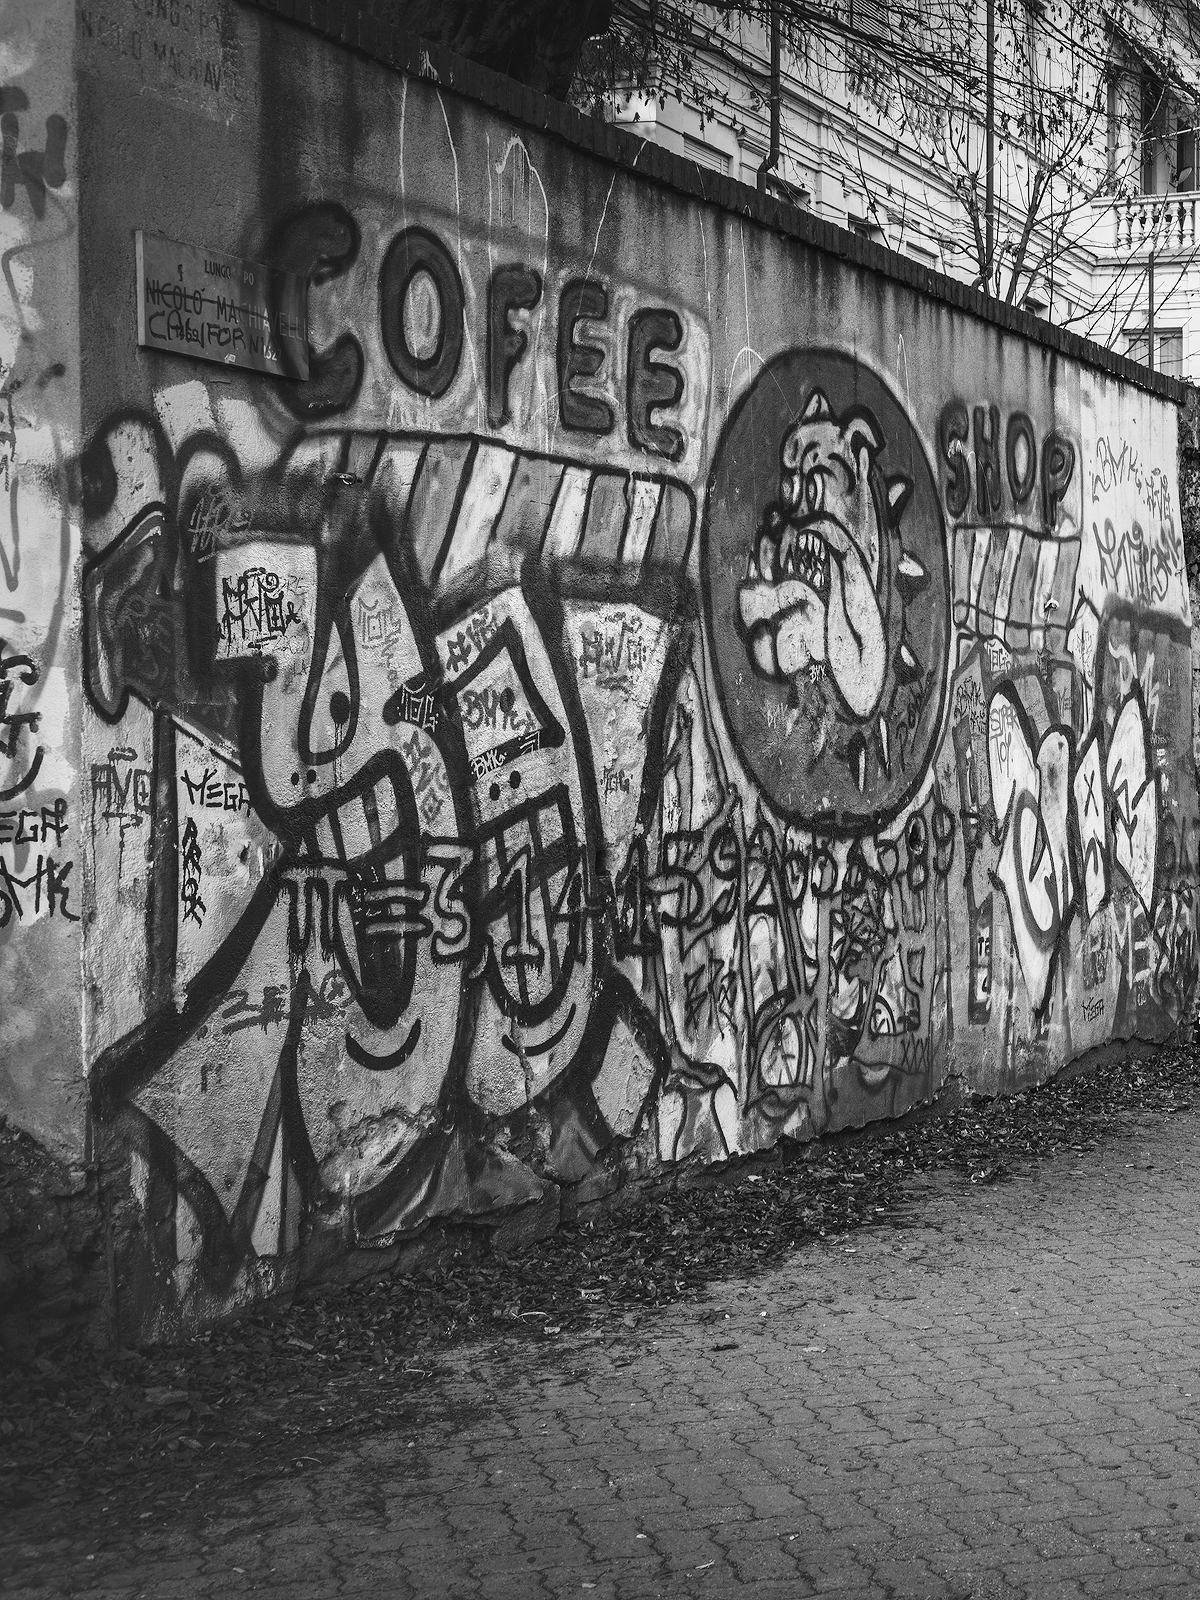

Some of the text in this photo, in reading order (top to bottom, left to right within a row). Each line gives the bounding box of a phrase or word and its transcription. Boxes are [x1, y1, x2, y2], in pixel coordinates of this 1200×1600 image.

[204, 260, 231, 279] LUNGO
[243, 271, 254, 286] PO
[216, 296, 307, 342] MACHIAVELLI
[936, 399, 1076, 518] SHOP
